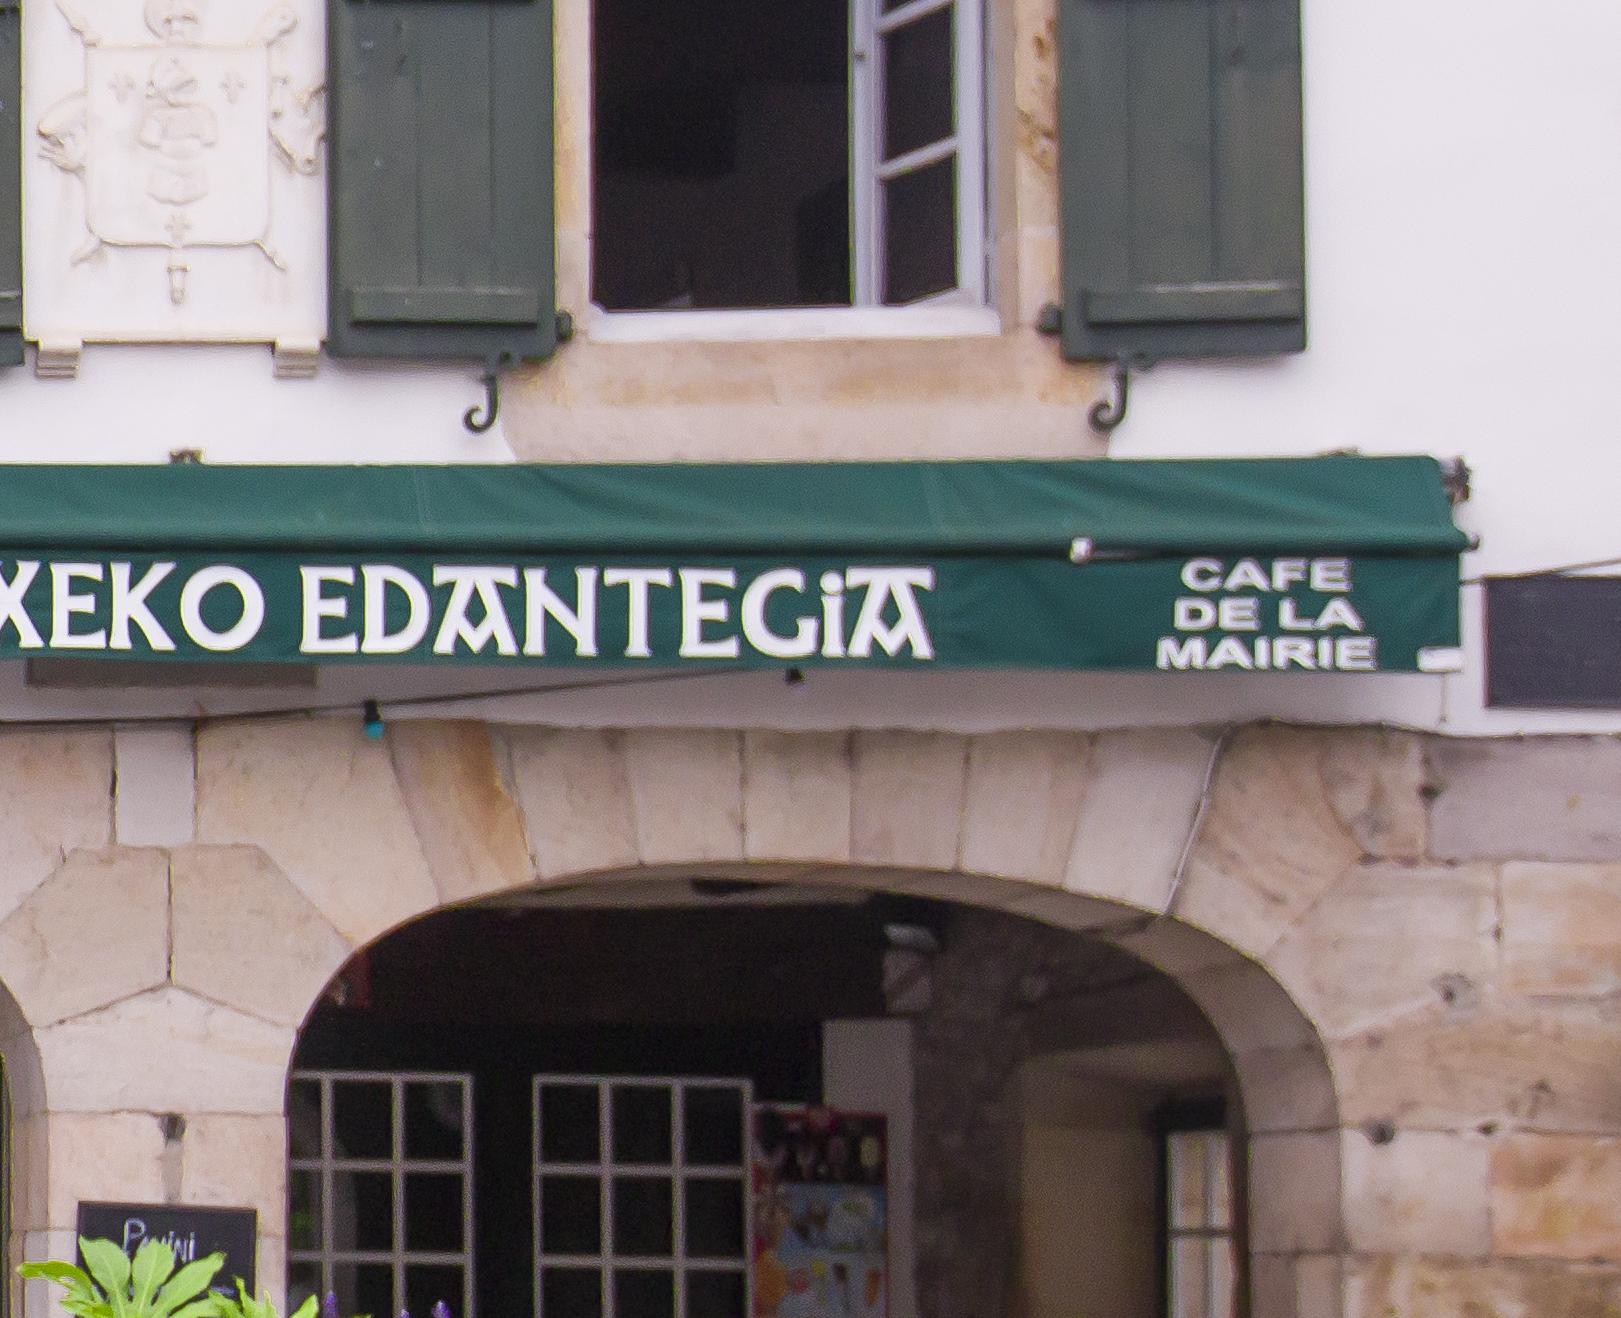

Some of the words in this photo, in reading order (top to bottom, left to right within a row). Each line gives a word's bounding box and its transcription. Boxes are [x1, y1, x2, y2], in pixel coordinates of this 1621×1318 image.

[1180, 557, 1352, 592] CAFE
[1173, 596, 1260, 631] DE
[1278, 596, 1365, 631] LA
[1156, 634, 1379, 671] MAIRIE
